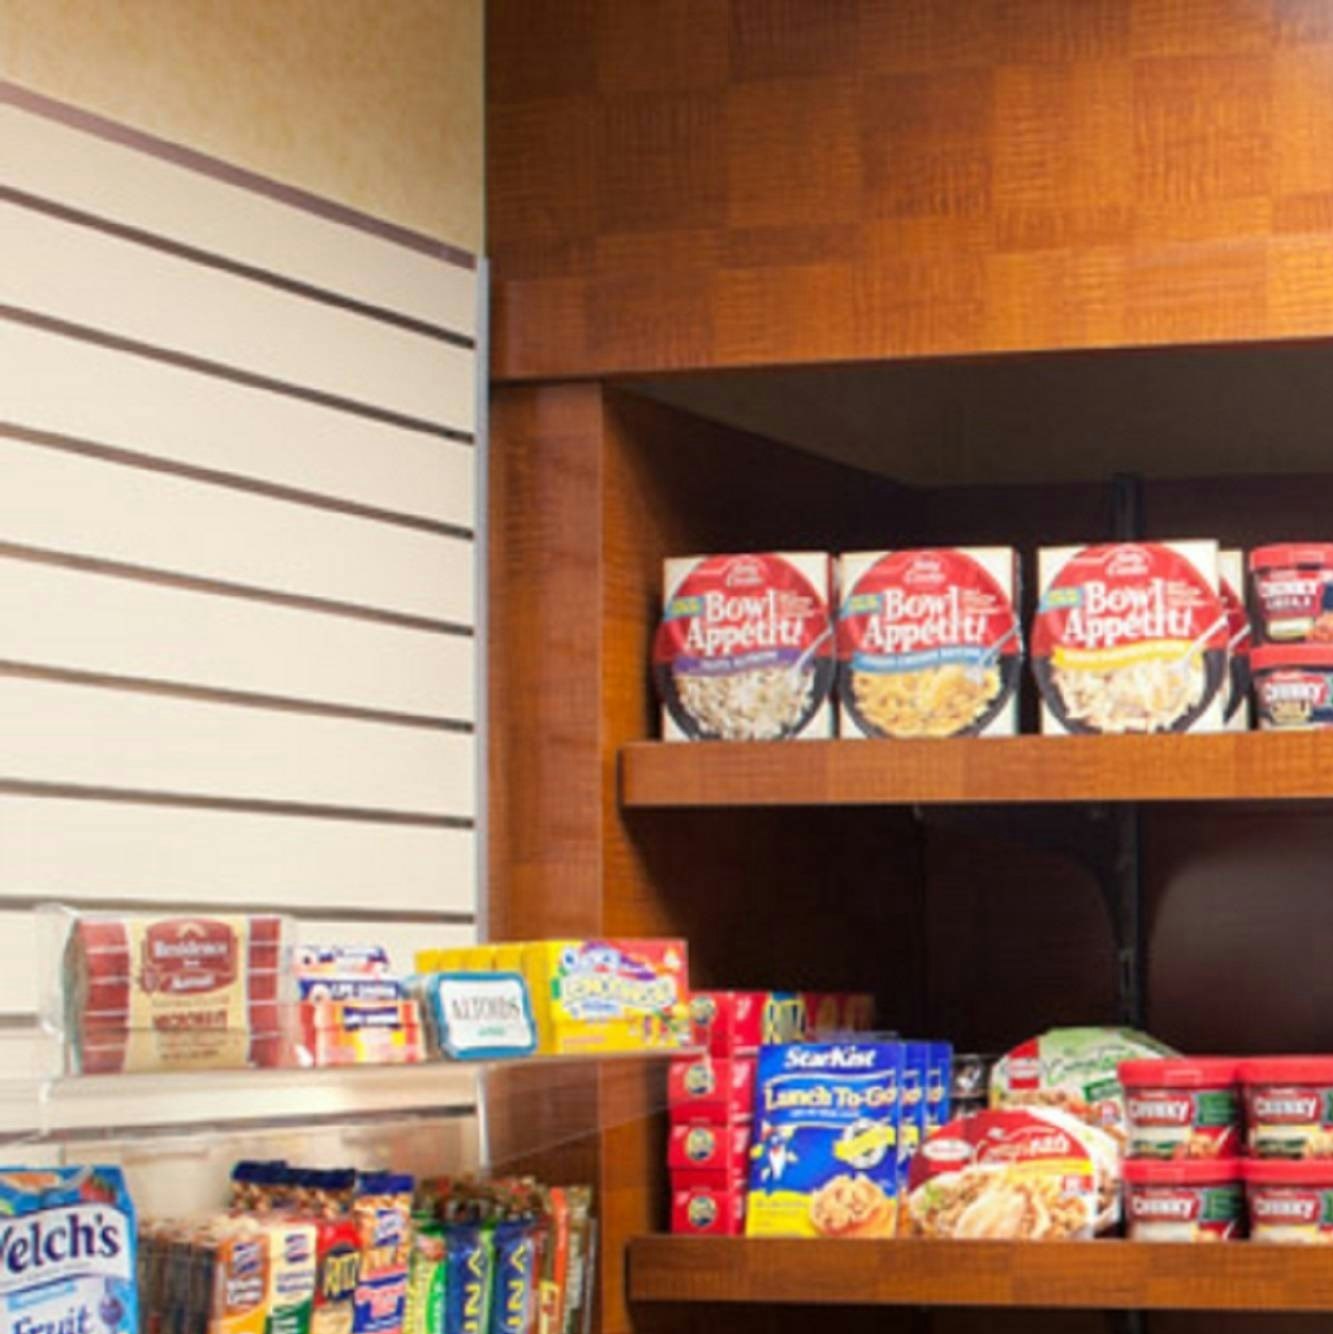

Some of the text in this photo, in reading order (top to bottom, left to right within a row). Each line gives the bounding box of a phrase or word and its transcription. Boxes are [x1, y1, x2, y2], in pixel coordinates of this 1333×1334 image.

[704, 588, 778, 624] Bowl
[884, 584, 959, 622] Bowl
[1083, 577, 1163, 615] Bowl
[784, 1045, 877, 1068] StarKist
[765, 1085, 832, 1112] Lunch
